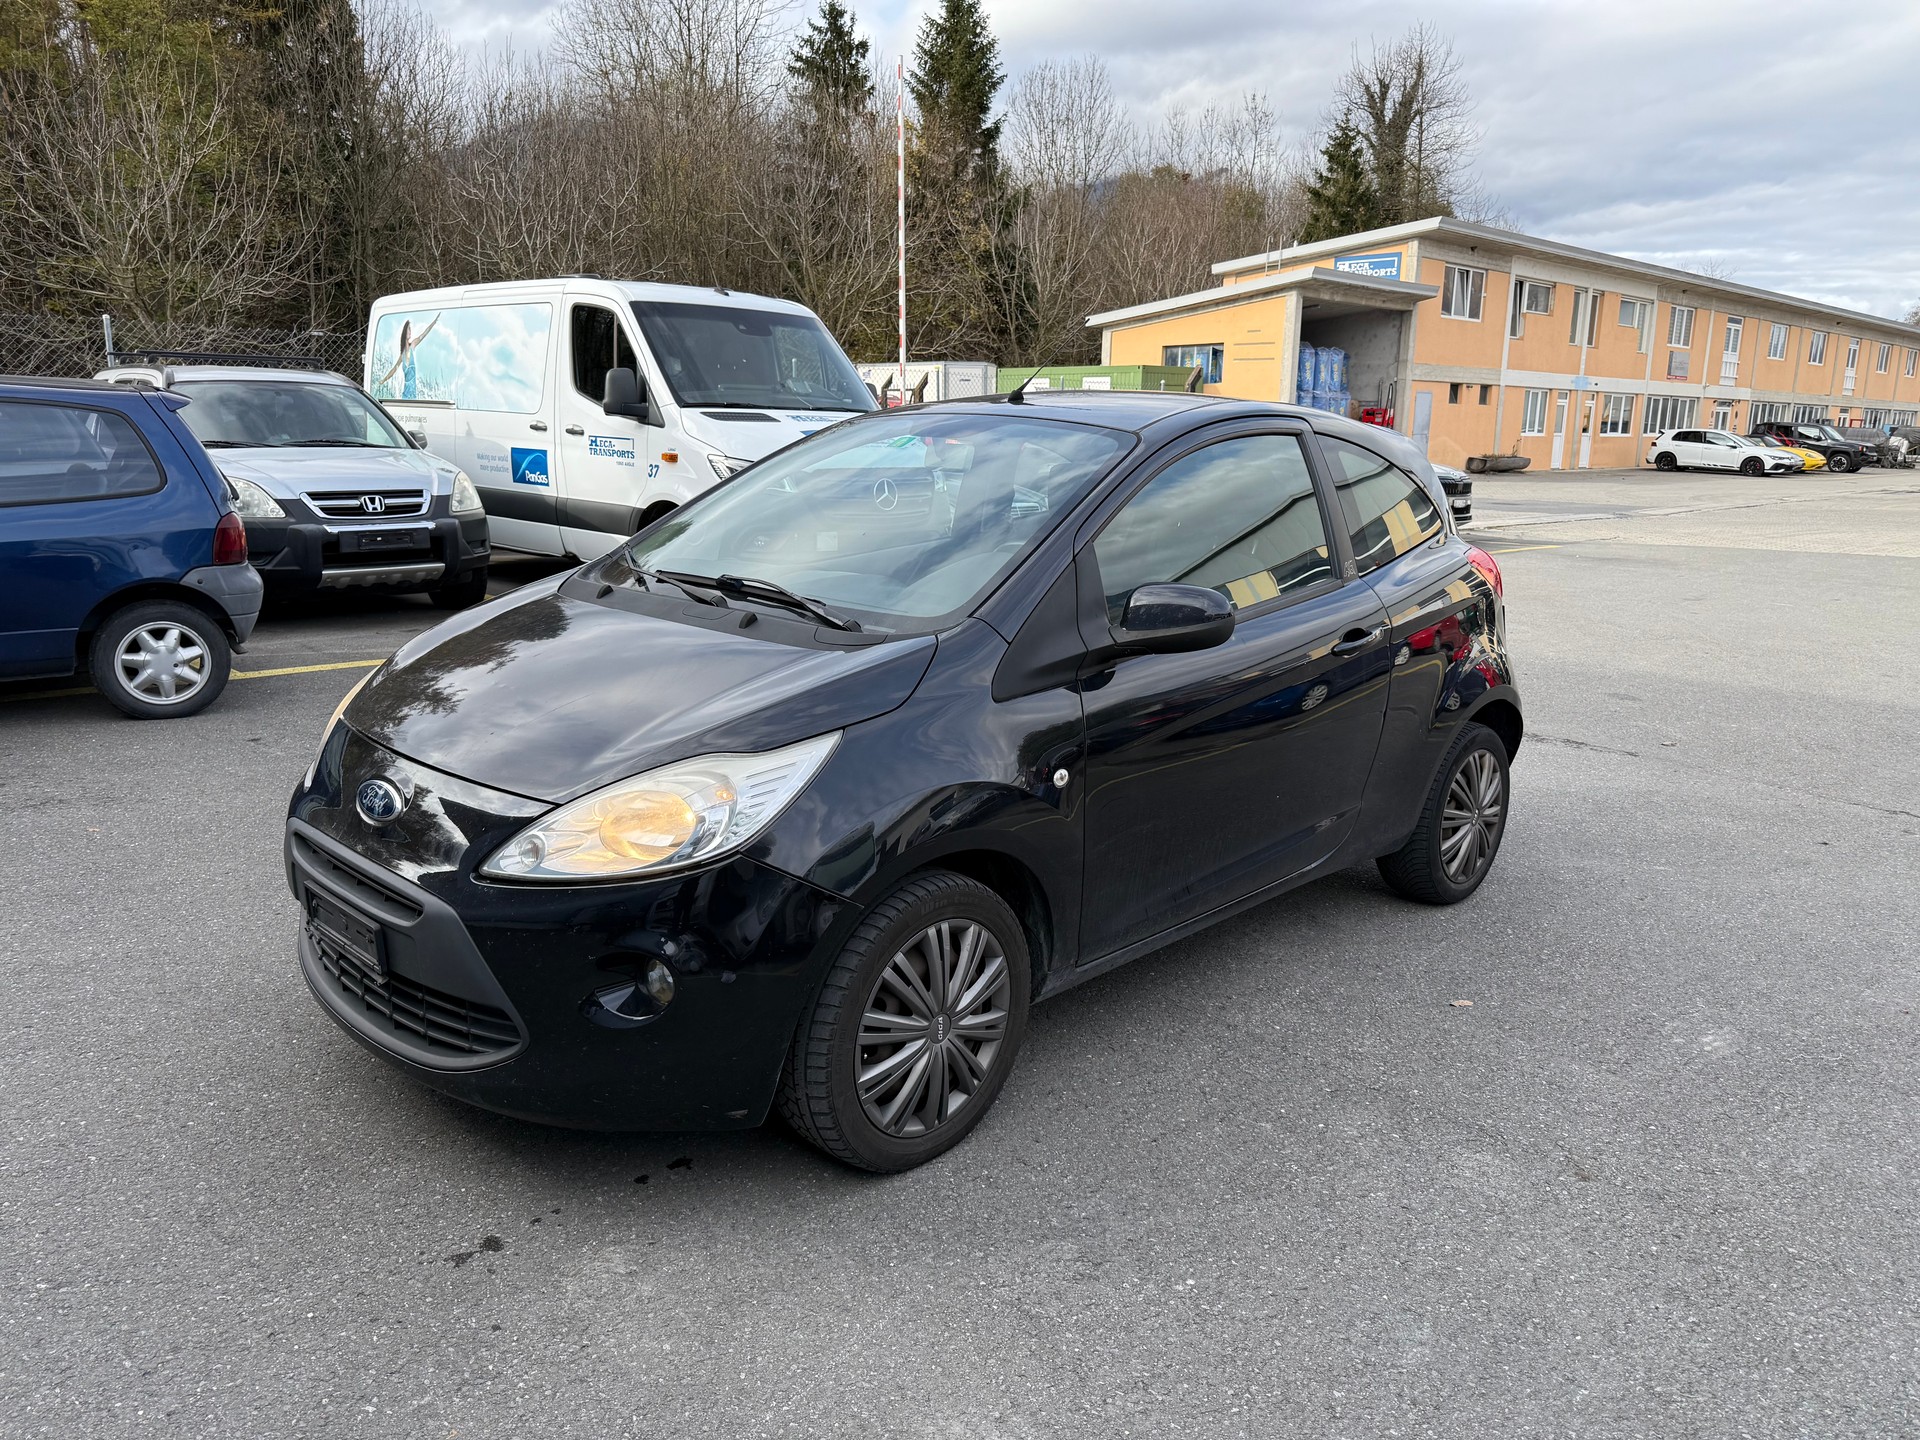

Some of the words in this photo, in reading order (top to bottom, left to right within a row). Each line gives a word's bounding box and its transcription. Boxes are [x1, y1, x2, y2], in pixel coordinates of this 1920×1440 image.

[498, 454, 509, 463] world
[589, 447, 635, 460] TRANSPORTS
[490, 465, 509, 474] productive
[647, 463, 660, 478] 37
[525, 470, 548, 484] PanGas
[362, 785, 388, 813] Ford
